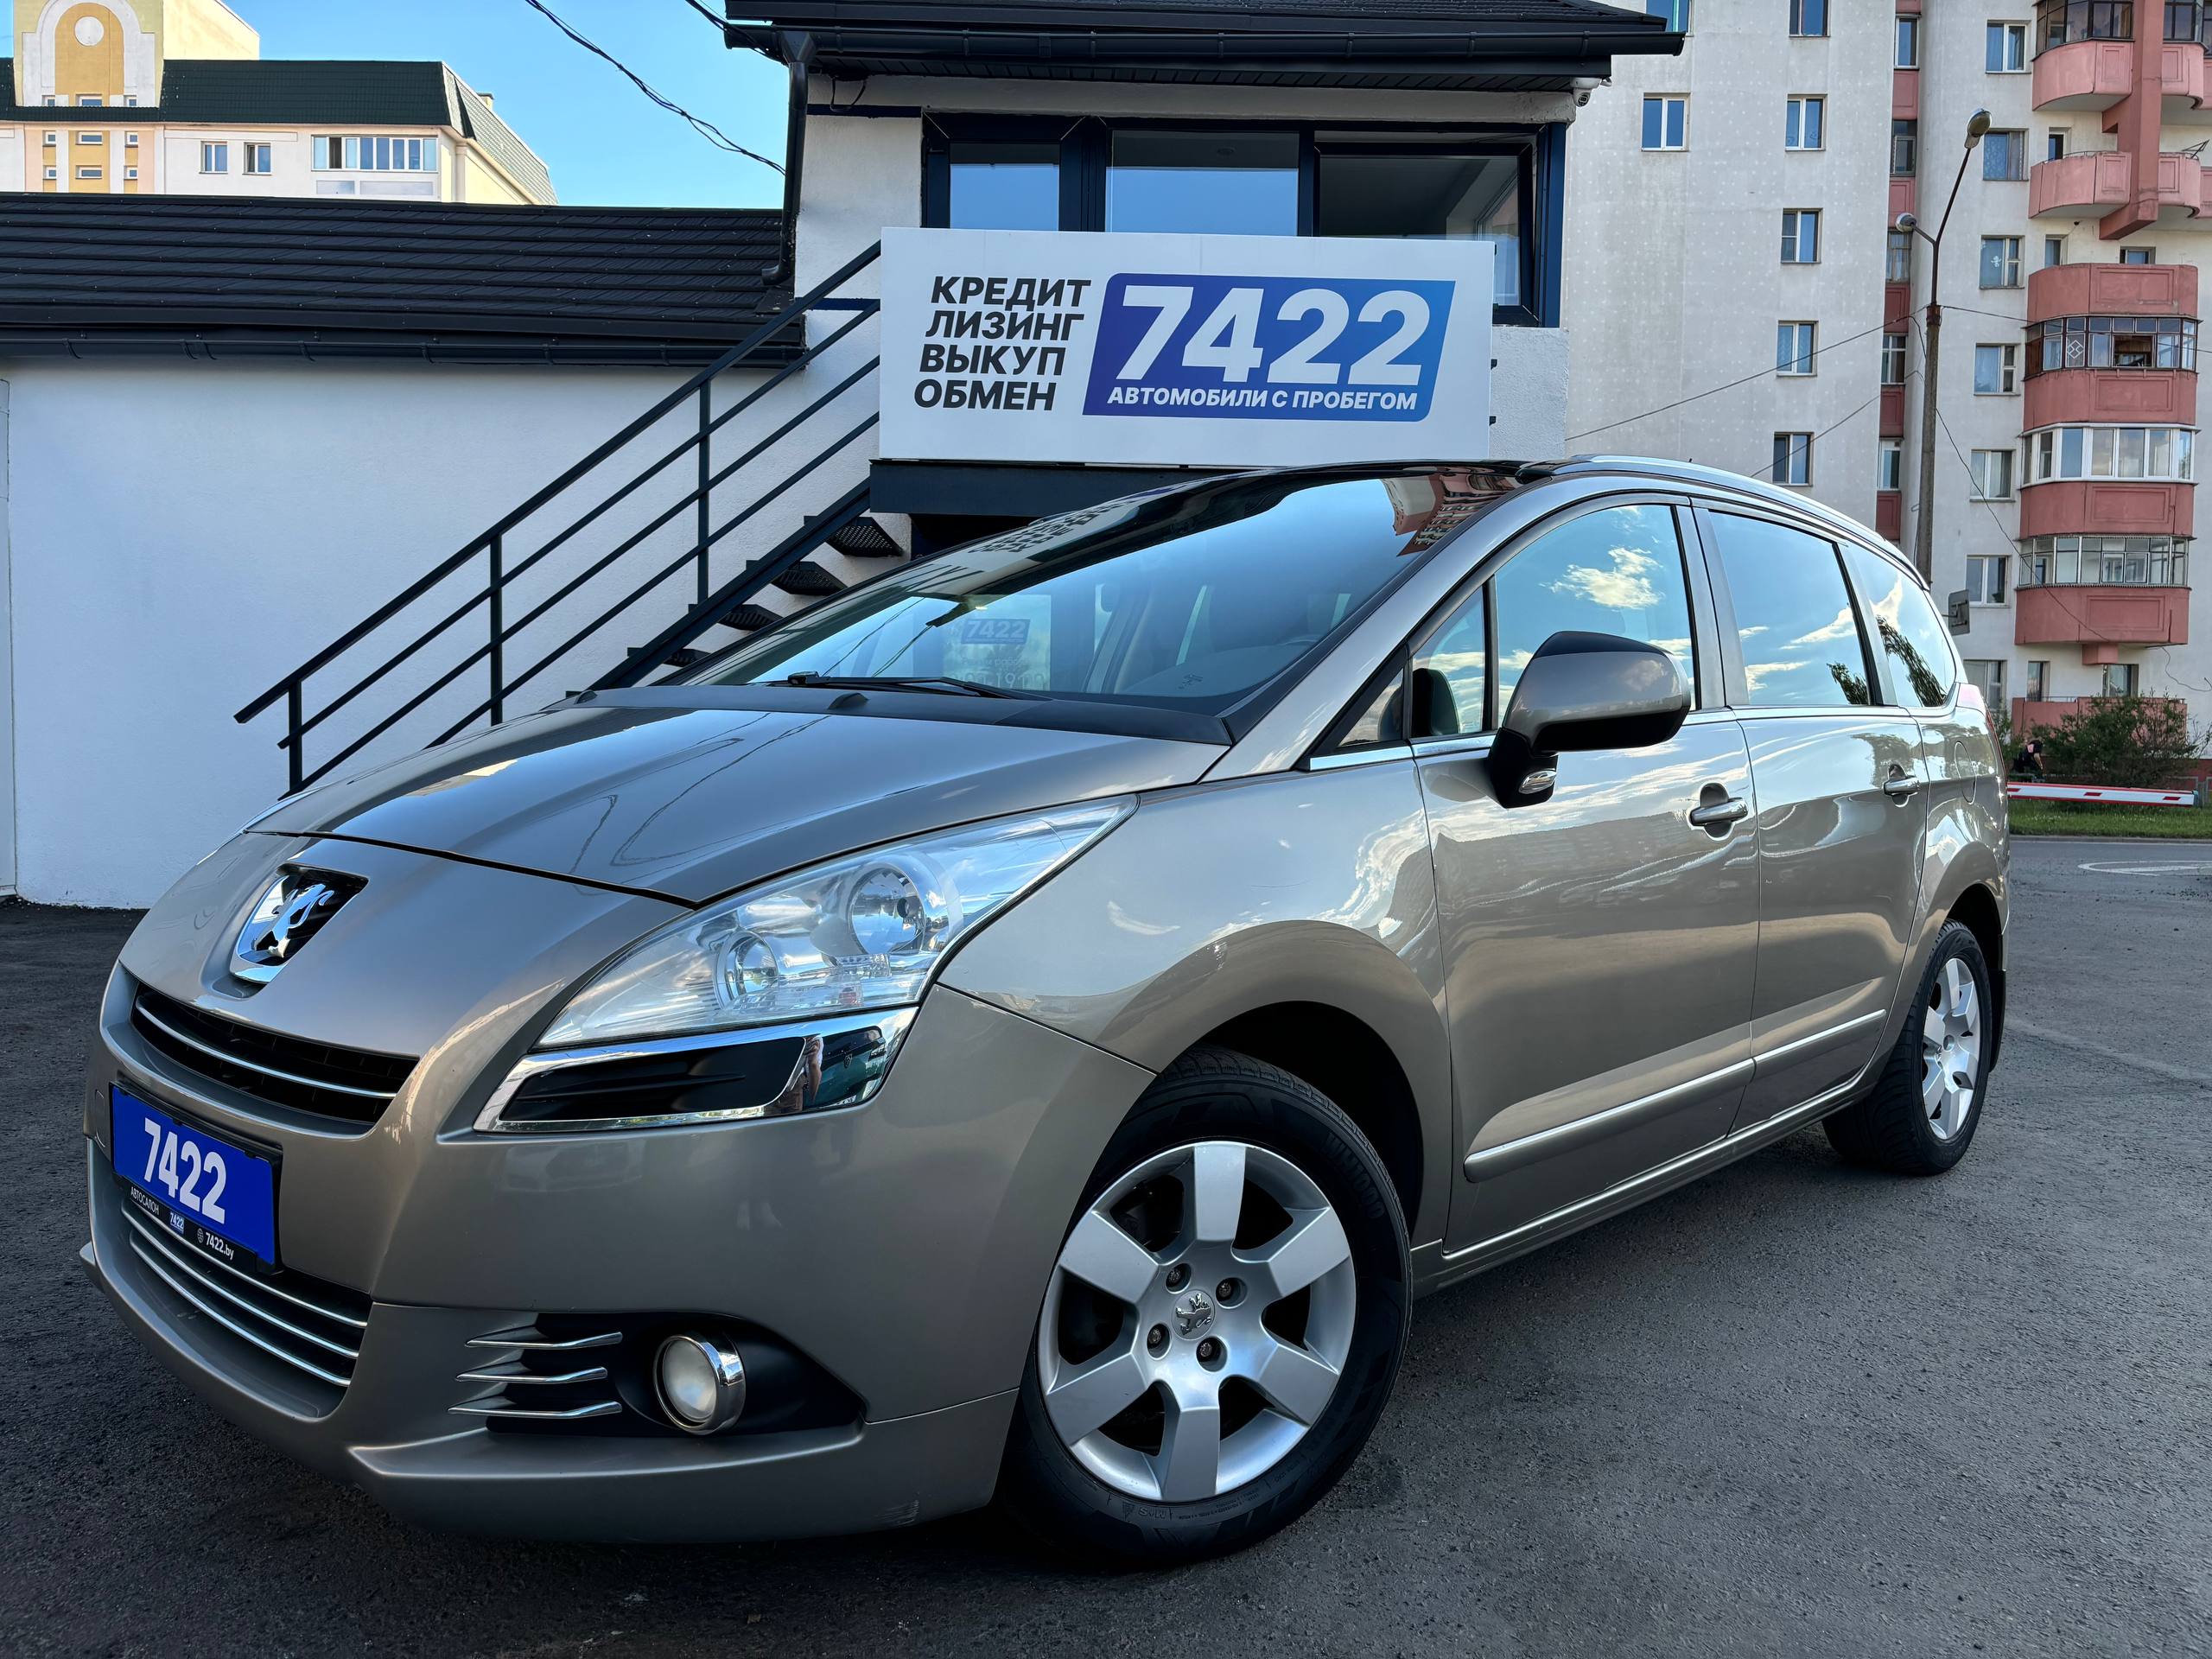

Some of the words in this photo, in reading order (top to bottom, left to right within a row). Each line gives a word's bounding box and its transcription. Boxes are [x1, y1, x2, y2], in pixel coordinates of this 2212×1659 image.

[931, 276, 1092, 311] КРЕДИТ
[925, 310, 1085, 341] ЛИЗИНГ
[1116, 285, 1430, 386] 7422
[918, 344, 1066, 376] ВЫКУП
[913, 379, 1057, 411] ОБМЕН
[1107, 386, 1268, 407] АВТОМОБИЛИ
[1271, 391, 1288, 408] С
[1292, 391, 1418, 410] ПРОБЕГОМ
[967, 620, 1027, 639] 7422
[143, 1117, 226, 1224] 7422
[130, 1186, 160, 1216] АВТОСАЛОН
[169, 1211, 184, 1228] 7422
[206, 1231, 234, 1261] 7422.by
